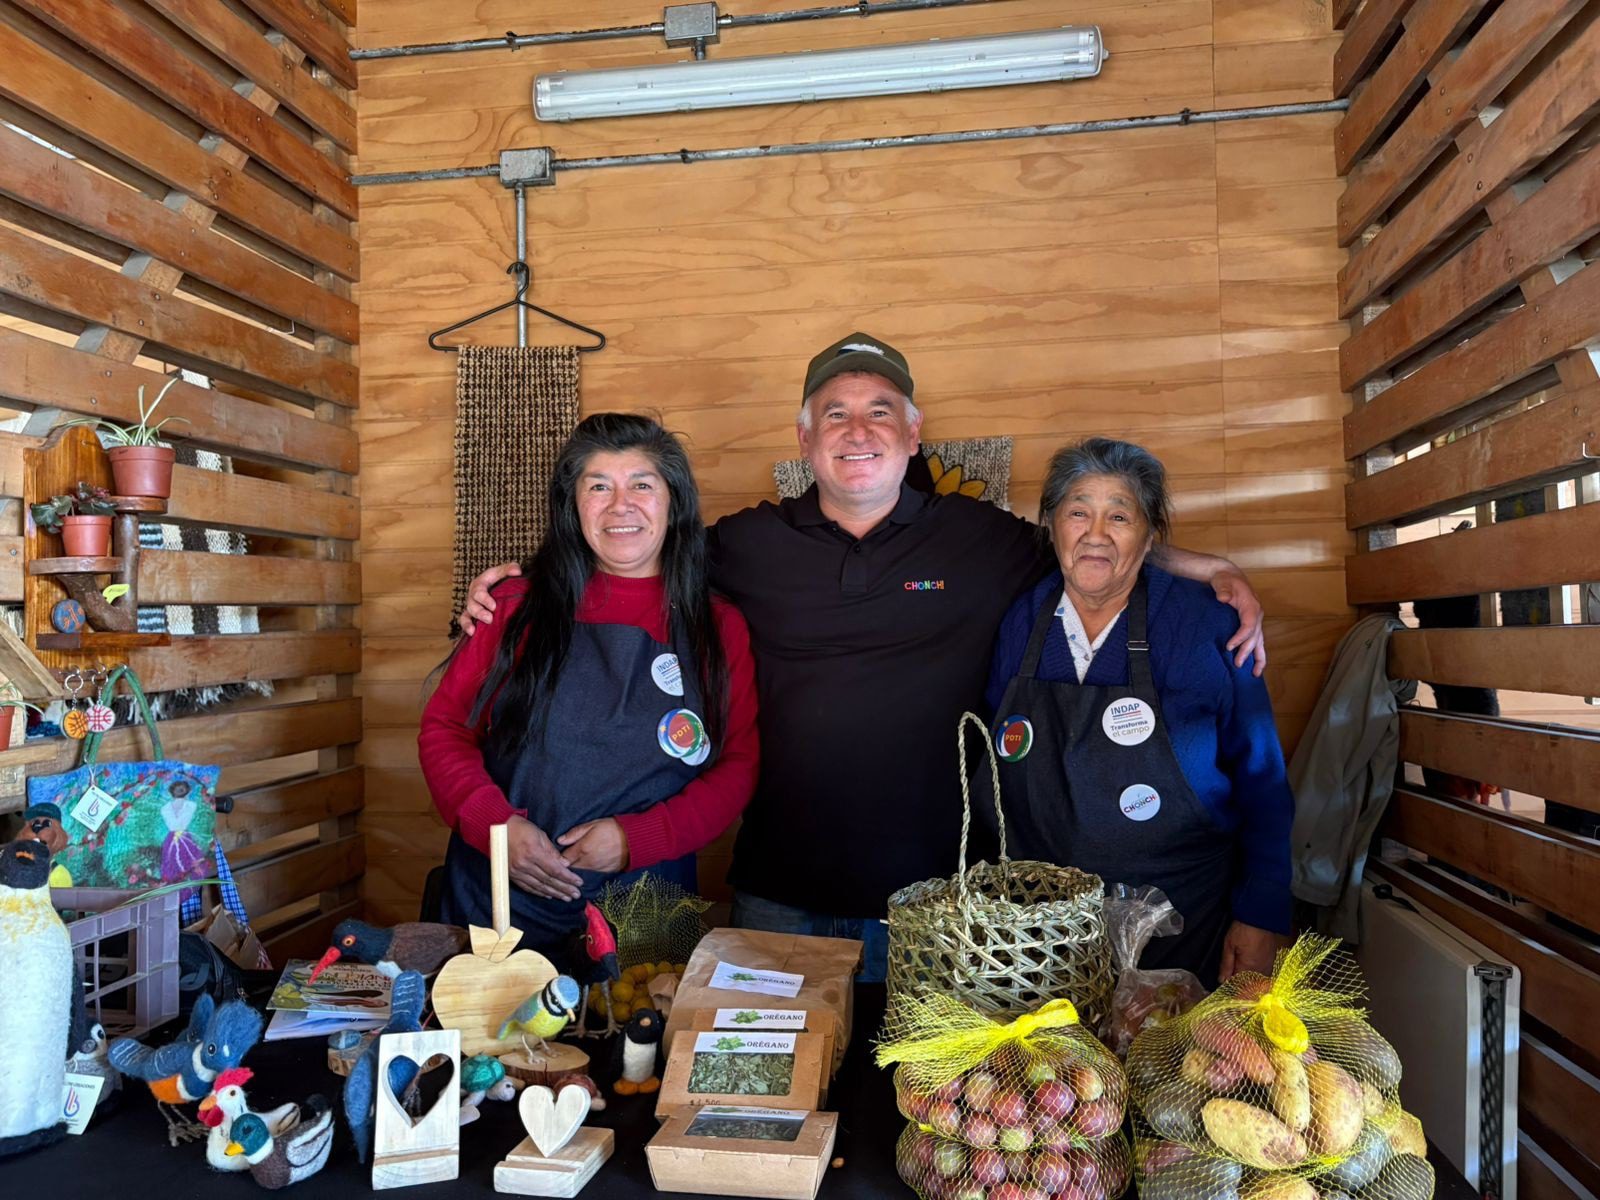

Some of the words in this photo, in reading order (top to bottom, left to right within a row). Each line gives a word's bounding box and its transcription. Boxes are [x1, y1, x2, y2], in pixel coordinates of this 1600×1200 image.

[904, 580, 945, 590] CHONCHI
[1111, 703, 1140, 715] INDAP
[1111, 720, 1148, 731] Transforma
[672, 724, 690, 741] PDTI
[1121, 726, 1150, 736] campo
[763, 1013, 804, 1021] ORÉGANO
[746, 1040, 789, 1049] ORÉGANO
